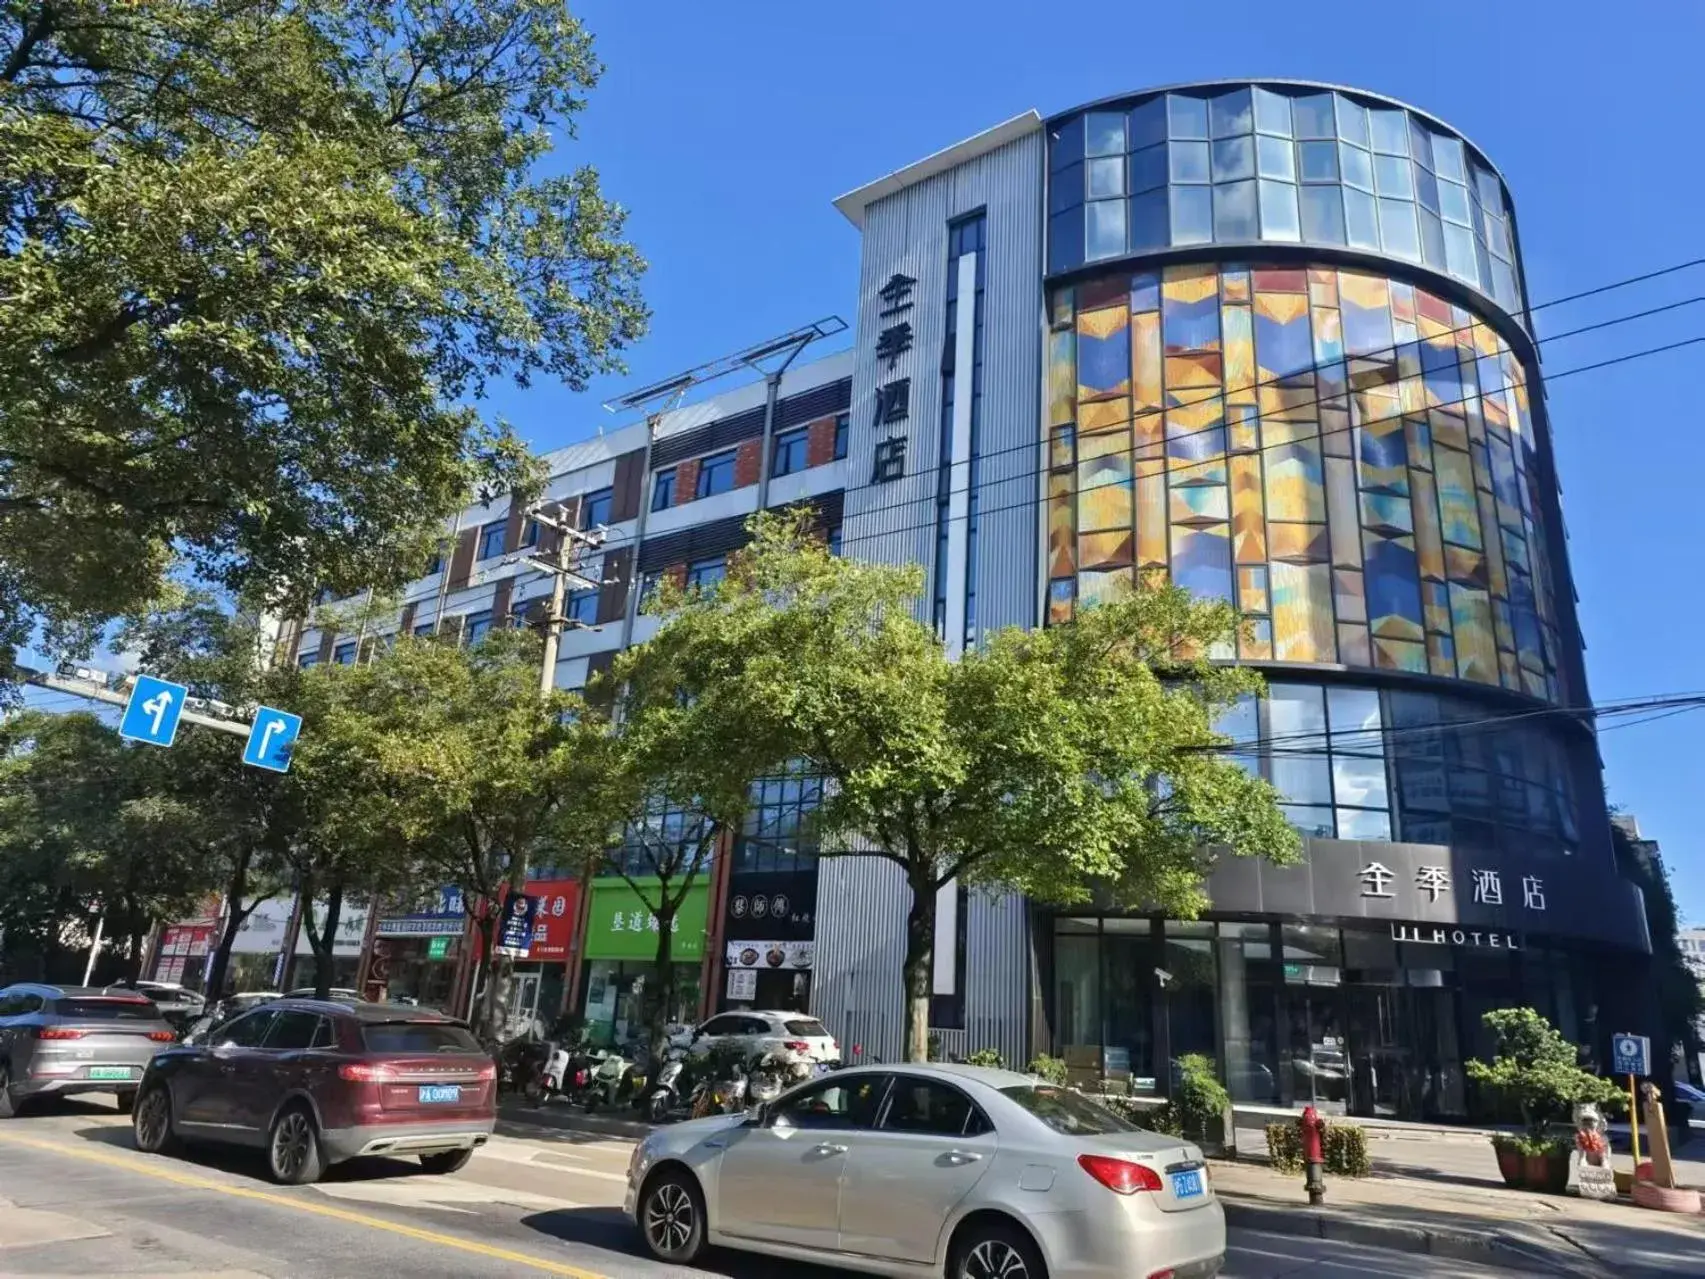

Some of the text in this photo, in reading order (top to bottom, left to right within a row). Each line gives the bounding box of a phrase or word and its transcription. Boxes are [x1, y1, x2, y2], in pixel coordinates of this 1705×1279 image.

[871, 273, 917, 484] 全季酒店
[1357, 862, 1546, 910] 全季酒店
[1433, 929, 1518, 949] HOTEL
